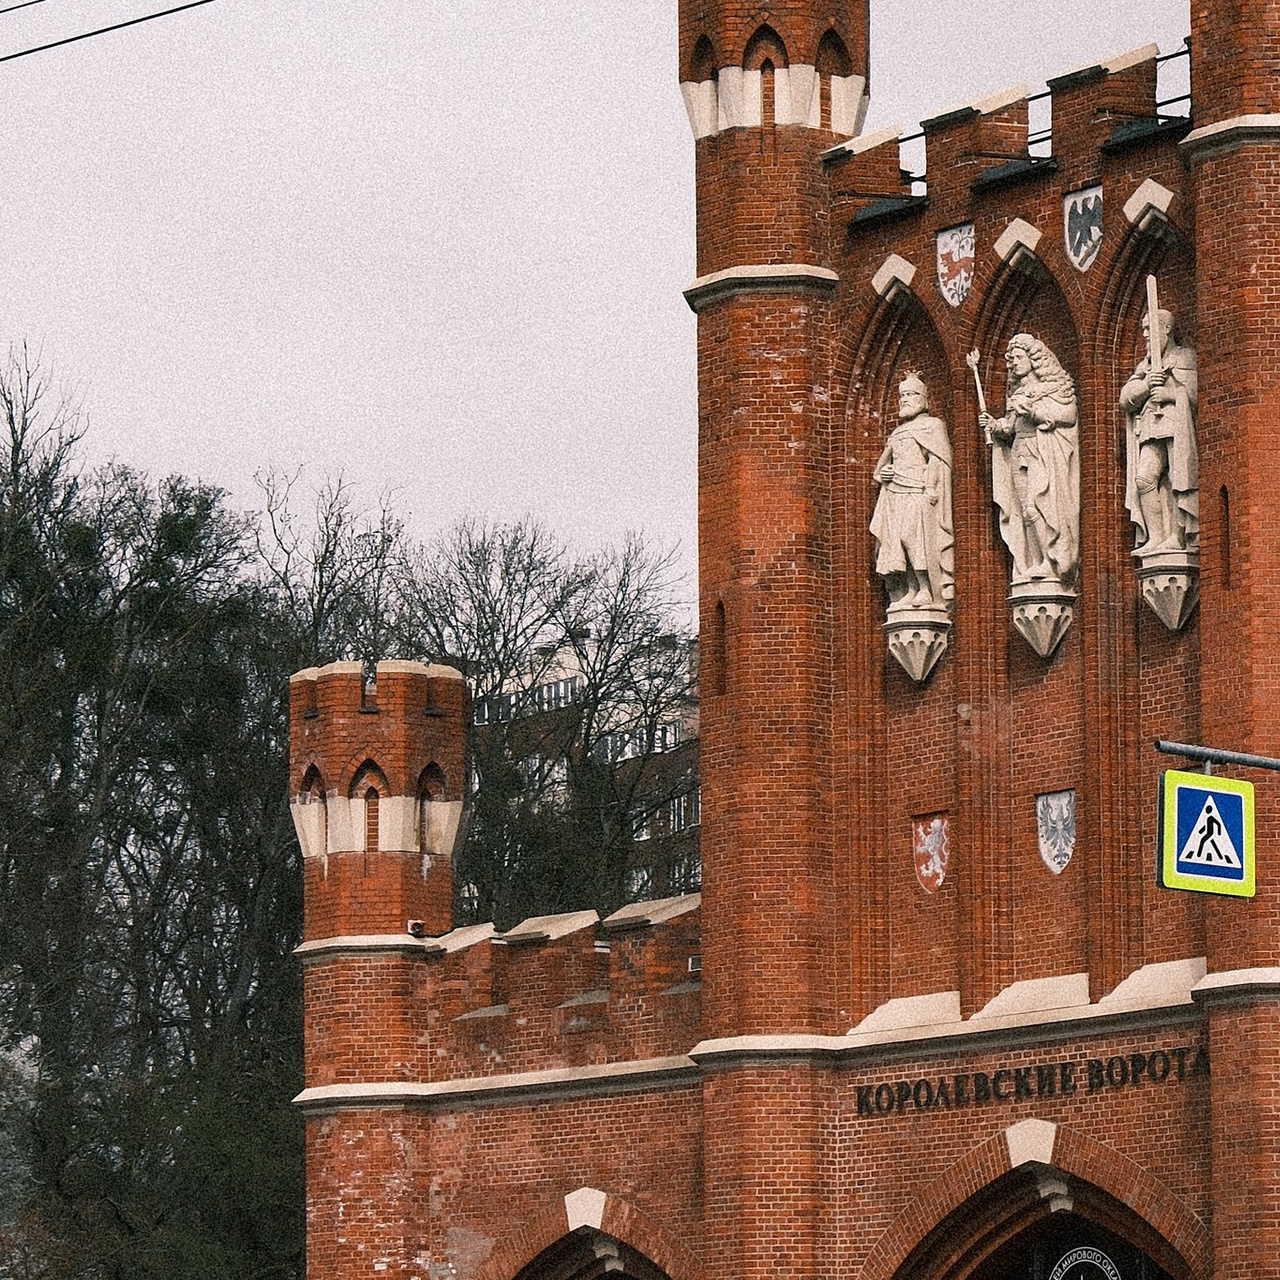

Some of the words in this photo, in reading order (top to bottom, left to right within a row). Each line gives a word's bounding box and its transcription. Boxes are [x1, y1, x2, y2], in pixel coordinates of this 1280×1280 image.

[856, 1062, 1077, 1117] КОРОЛЕВСКИЕ
[1087, 1046, 1211, 1091] ВОРОТА
[1061, 1250, 1102, 1271] МИРОВОГО
